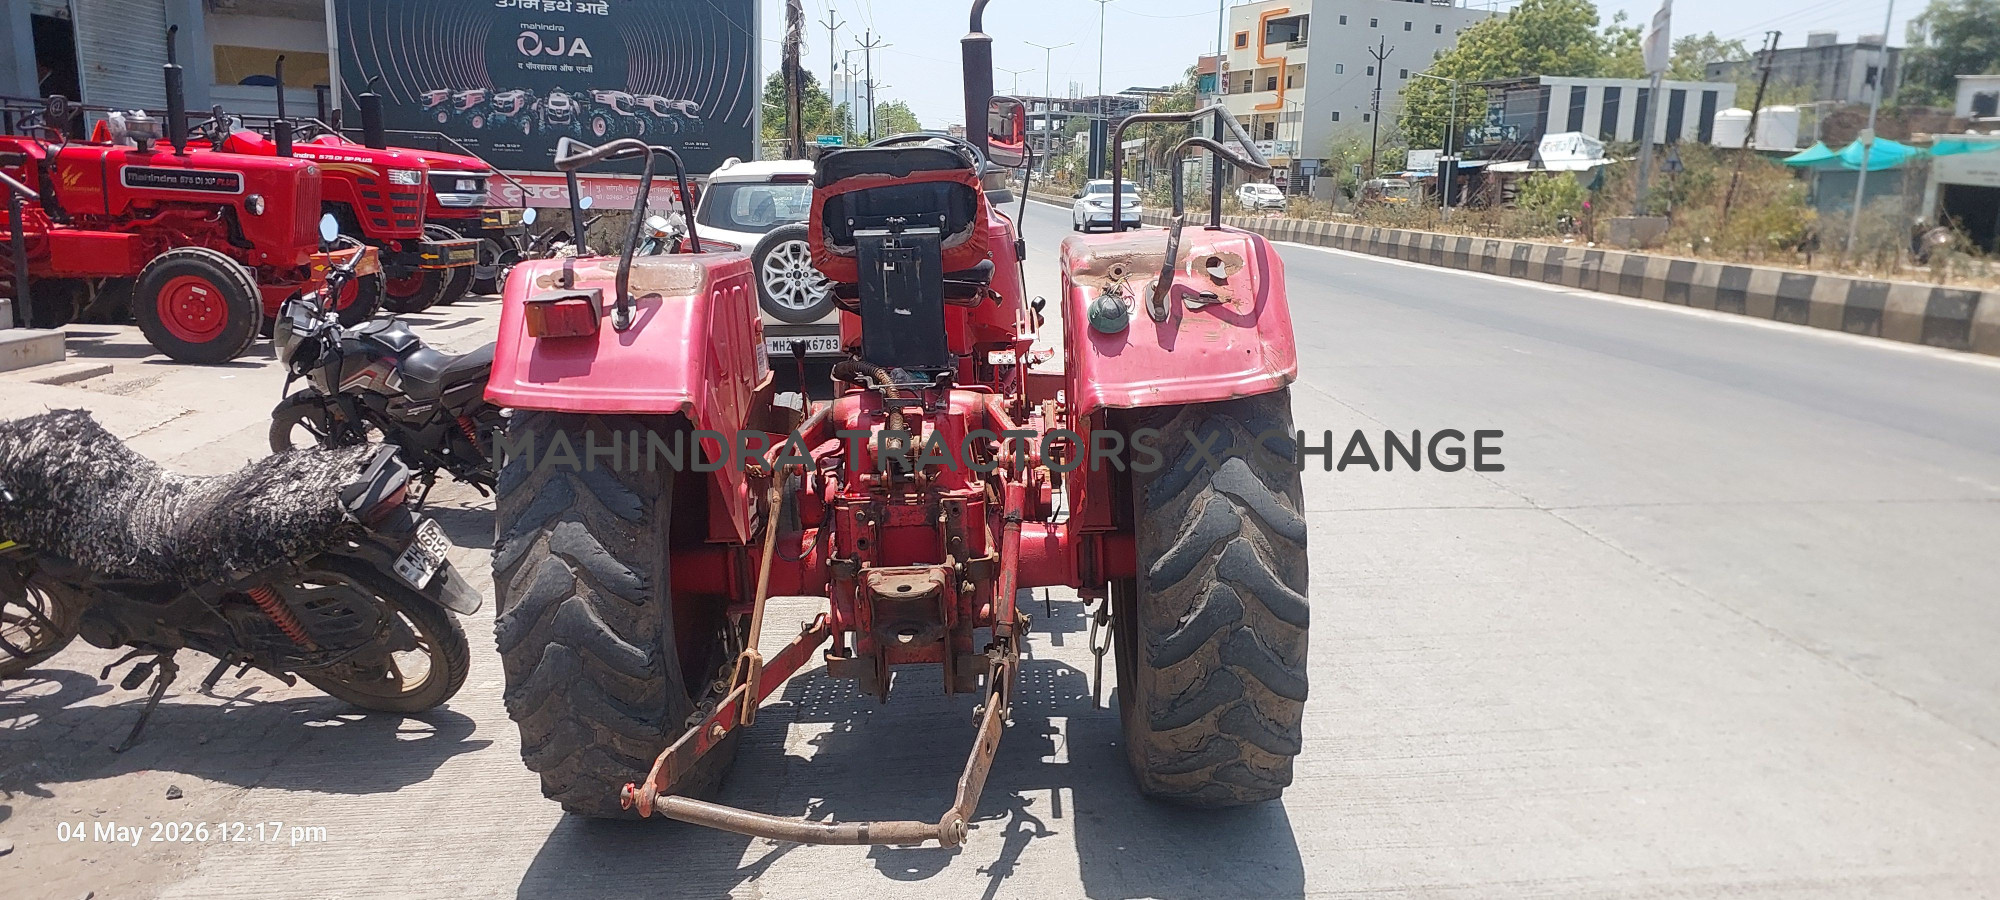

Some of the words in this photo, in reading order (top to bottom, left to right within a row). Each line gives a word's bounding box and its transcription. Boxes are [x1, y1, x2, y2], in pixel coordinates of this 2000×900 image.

[575, 1, 609, 16] आहे
[520, 22, 565, 32] mahindra
[516, 31, 592, 58] OJA
[127, 171, 177, 183] Mahindra
[772, 338, 838, 352] MH2K6783
